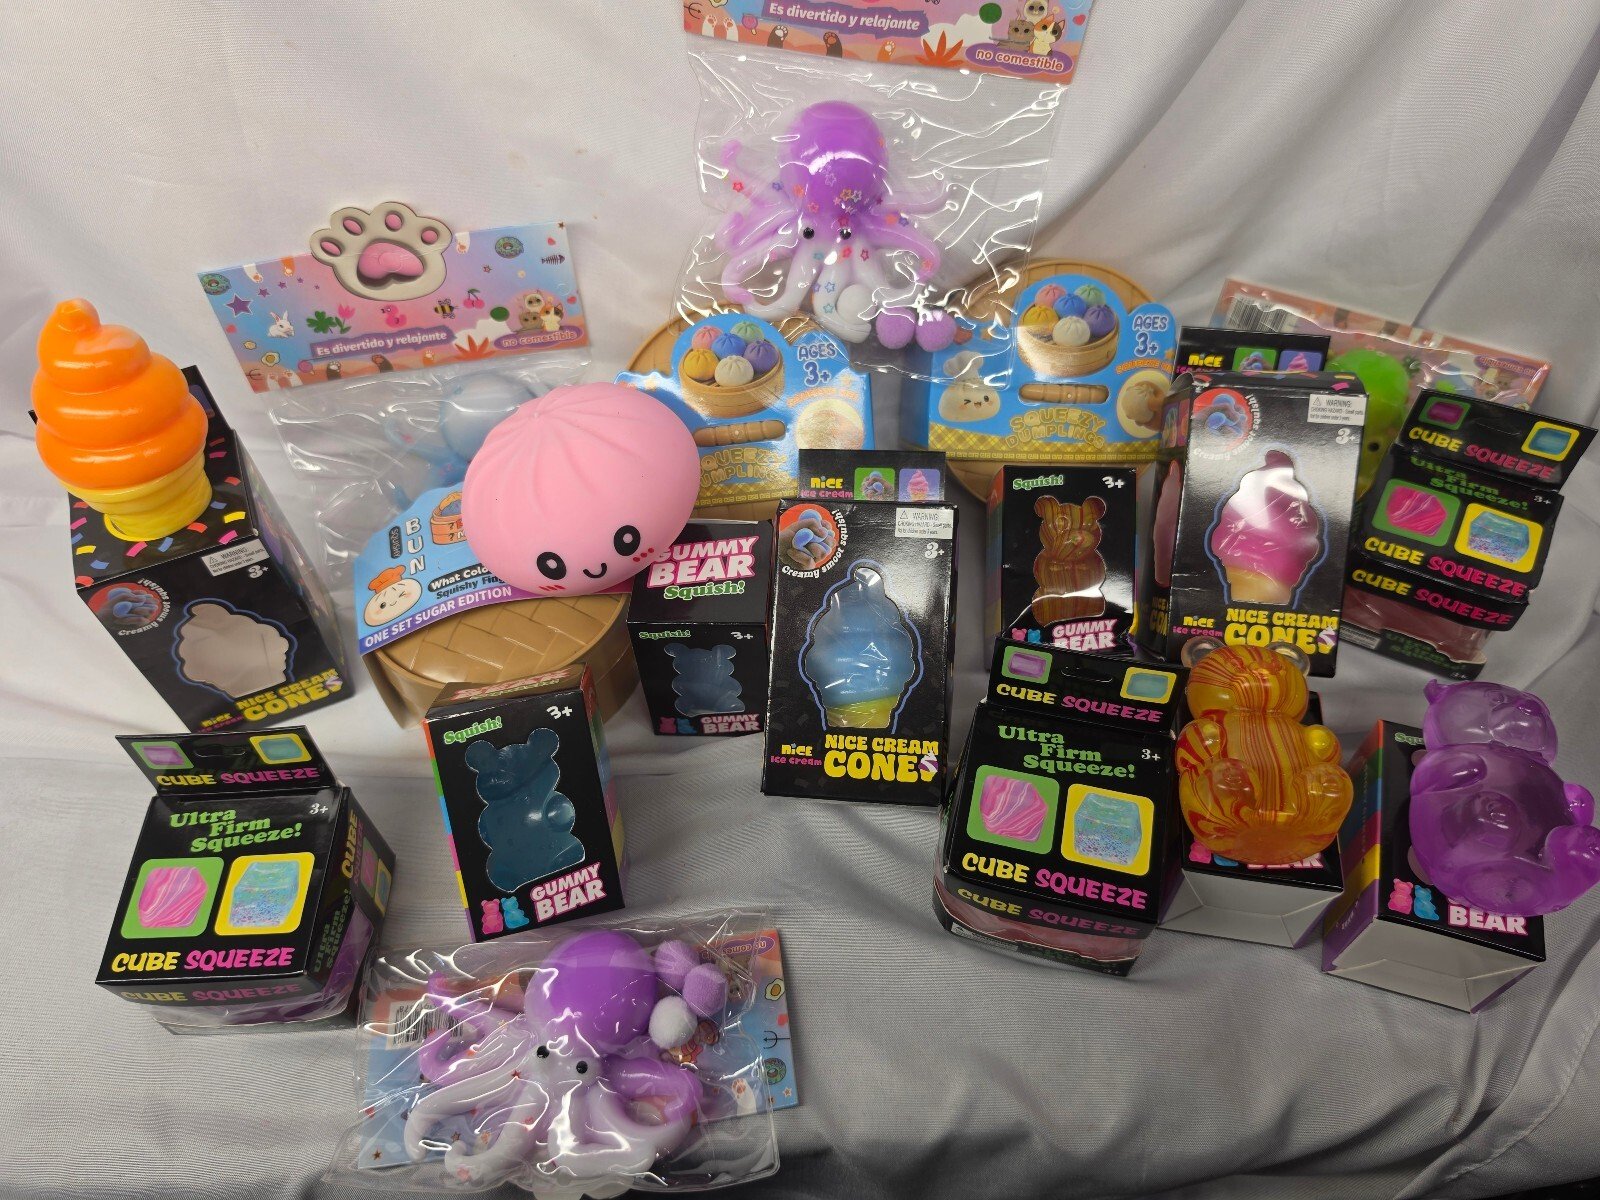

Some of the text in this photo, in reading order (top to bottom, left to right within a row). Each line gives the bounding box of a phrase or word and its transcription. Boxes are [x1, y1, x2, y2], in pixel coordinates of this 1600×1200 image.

[769, 2, 921, 32] Es divertido y relajante
[975, 49, 1064, 72] no comestible
[1133, 314, 1170, 332] AGES
[316, 330, 448, 356] Es divertido y relajante
[503, 330, 578, 348] no comestible
[1134, 332, 1158, 357] 3+
[798, 344, 836, 362] AGES
[803, 361, 831, 387] 3+
[1010, 407, 1106, 432] SQUEEZY
[1005, 424, 1105, 449] DUMPLINGS
[1335, 428, 1356, 445] 3+
[700, 447, 788, 474] QUEEZY
[1408, 426, 1556, 480] CUBE SQUEEZE
[700, 464, 791, 488] UMPLINGS
[1409, 455, 1469, 479] Ultra
[1013, 475, 1064, 490] Squish!
[1102, 476, 1125, 489] 3+
[1445, 474, 1500, 496] Firm
[819, 490, 853, 498] cream
[1429, 477, 1529, 511] Squeeze!
[1533, 494, 1552, 506] 3+
[405, 517, 425, 575] BUN
[925, 542, 945, 559] 3+
[248, 565, 269, 578] 3+
[649, 555, 756, 588] BEAR
[782, 565, 820, 579] Creamy
[1364, 536, 1528, 597] CUBE SQUEEZE
[431, 566, 489, 591] What Colo
[436, 578, 479, 599] Squishy
[664, 581, 745, 600] Squish!
[1352, 568, 1514, 625] CUBE SQUEEZE
[365, 586, 513, 648] ONE SET SUGAR EDITION
[1226, 608, 1340, 630] NICE CREAM
[118, 621, 159, 636] Creamy
[731, 631, 754, 640] 3+
[1053, 619, 1117, 638] GUMMY
[1172, 626, 1223, 638] ice cream
[1054, 632, 1116, 652] BEAR
[235, 668, 340, 710] NICE CREAM
[546, 705, 573, 720] 3+
[996, 683, 1164, 724] CUBE SQUEEZE
[700, 713, 760, 724] GUMMY
[703, 721, 760, 734] BEAR
[443, 716, 503, 745] Squish!
[998, 725, 1065, 745] Ultra
[825, 734, 939, 756] NICE CREAM
[1039, 742, 1102, 762] Firm
[1141, 748, 1161, 762] 3+
[770, 755, 822, 766] ice cream
[1023, 754, 1137, 779] Squeeze!
[156, 767, 321, 787] CUBE SQUEEZE
[169, 809, 237, 829] Ultra
[309, 802, 329, 815] 3+
[190, 822, 303, 854] Squeeze!
[209, 817, 271, 838] Firm
[341, 808, 358, 880] CUBE
[530, 861, 602, 901] GUMMY
[961, 852, 1149, 911] CUBE SQUEEZE
[535, 879, 608, 924] BEAR
[956, 887, 1023, 916] CUBE
[1027, 908, 1140, 937] SQUEEZE
[1448, 904, 1529, 936] BEAR
[111, 947, 295, 973] CUBE SQUEEZE
[120, 983, 303, 1002] CUBE SQUEEZE
